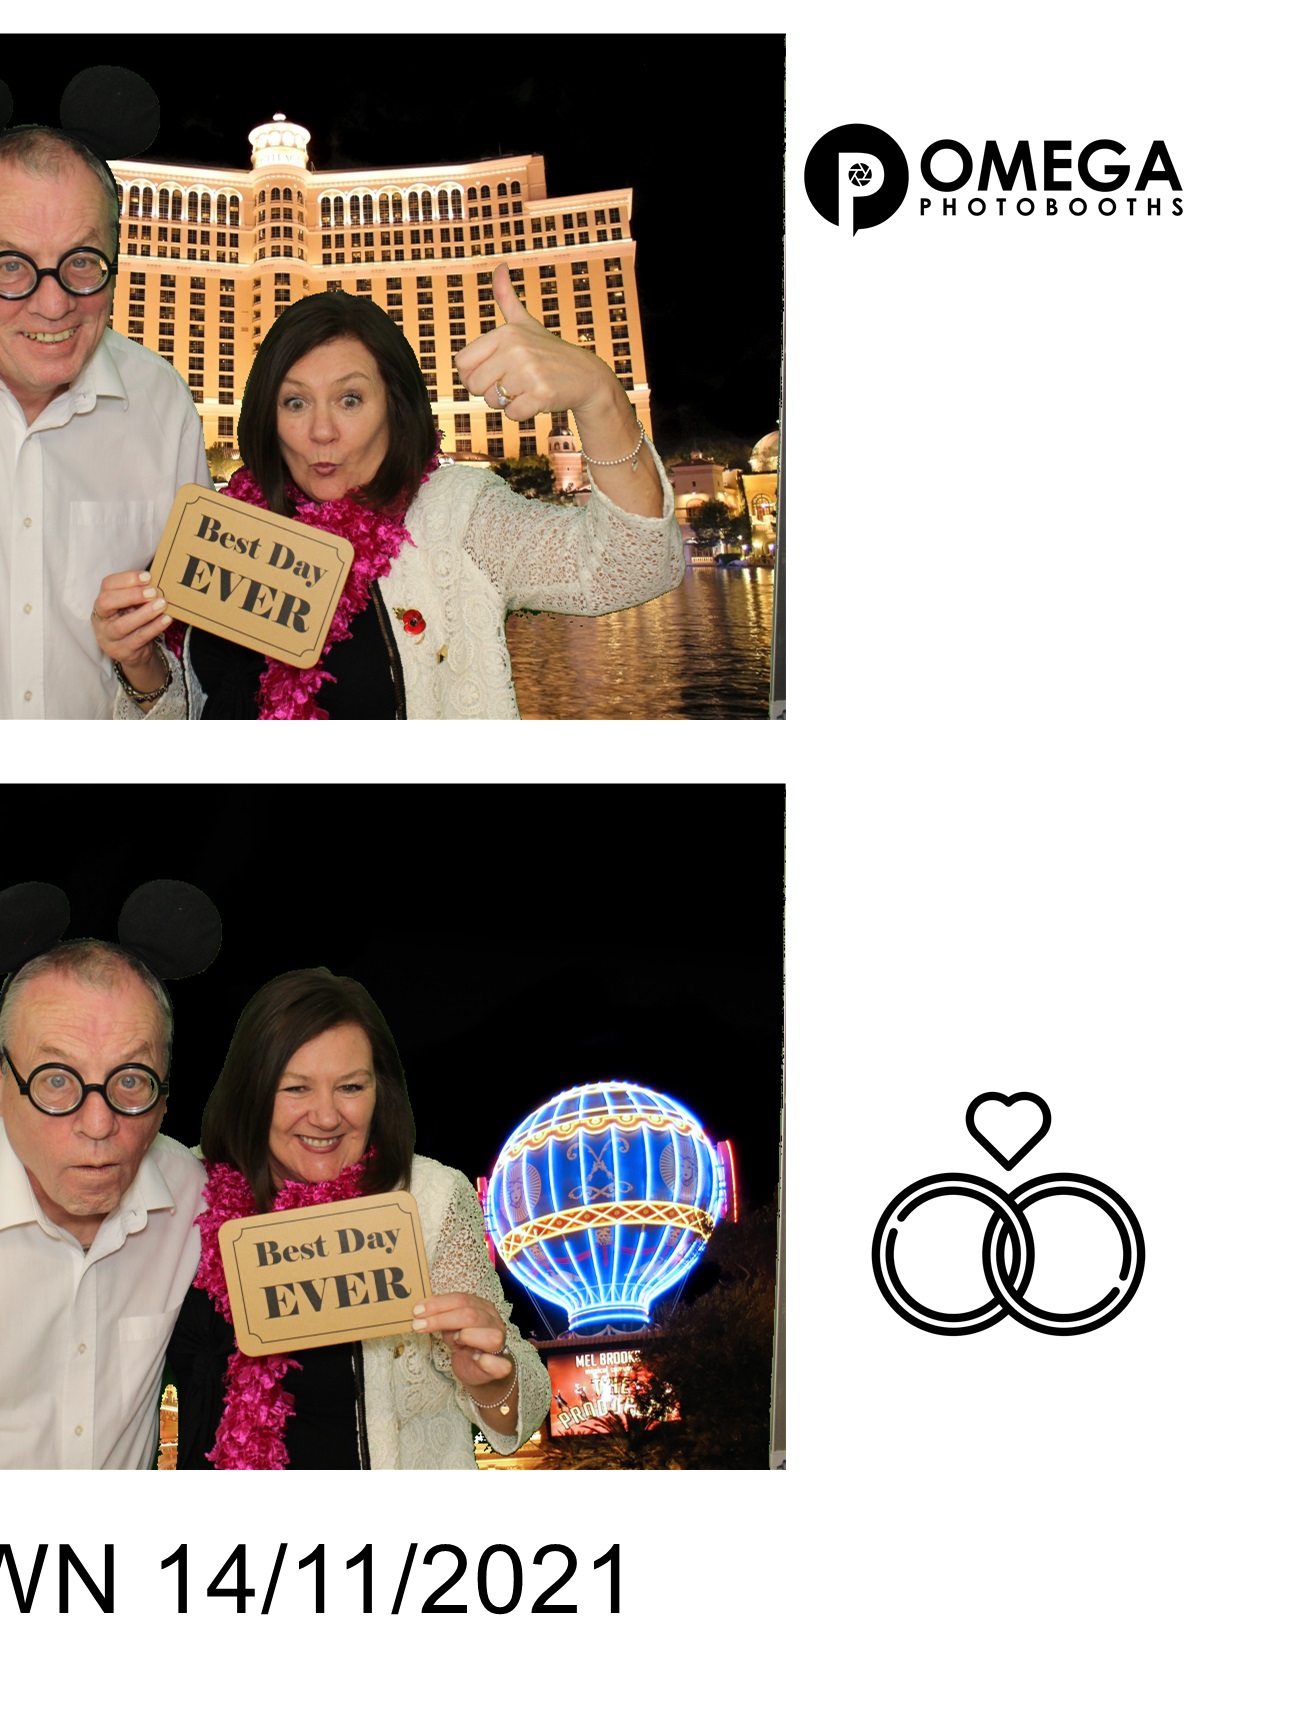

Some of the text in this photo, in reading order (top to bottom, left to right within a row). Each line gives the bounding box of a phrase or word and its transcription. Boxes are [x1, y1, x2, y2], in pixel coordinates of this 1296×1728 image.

[194, 513, 328, 588] Best Day
[177, 553, 311, 633] EVER
[253, 1227, 401, 1268] Best Day
[259, 1266, 412, 1320] EVER
[575, 1354, 596, 1368] MEL
